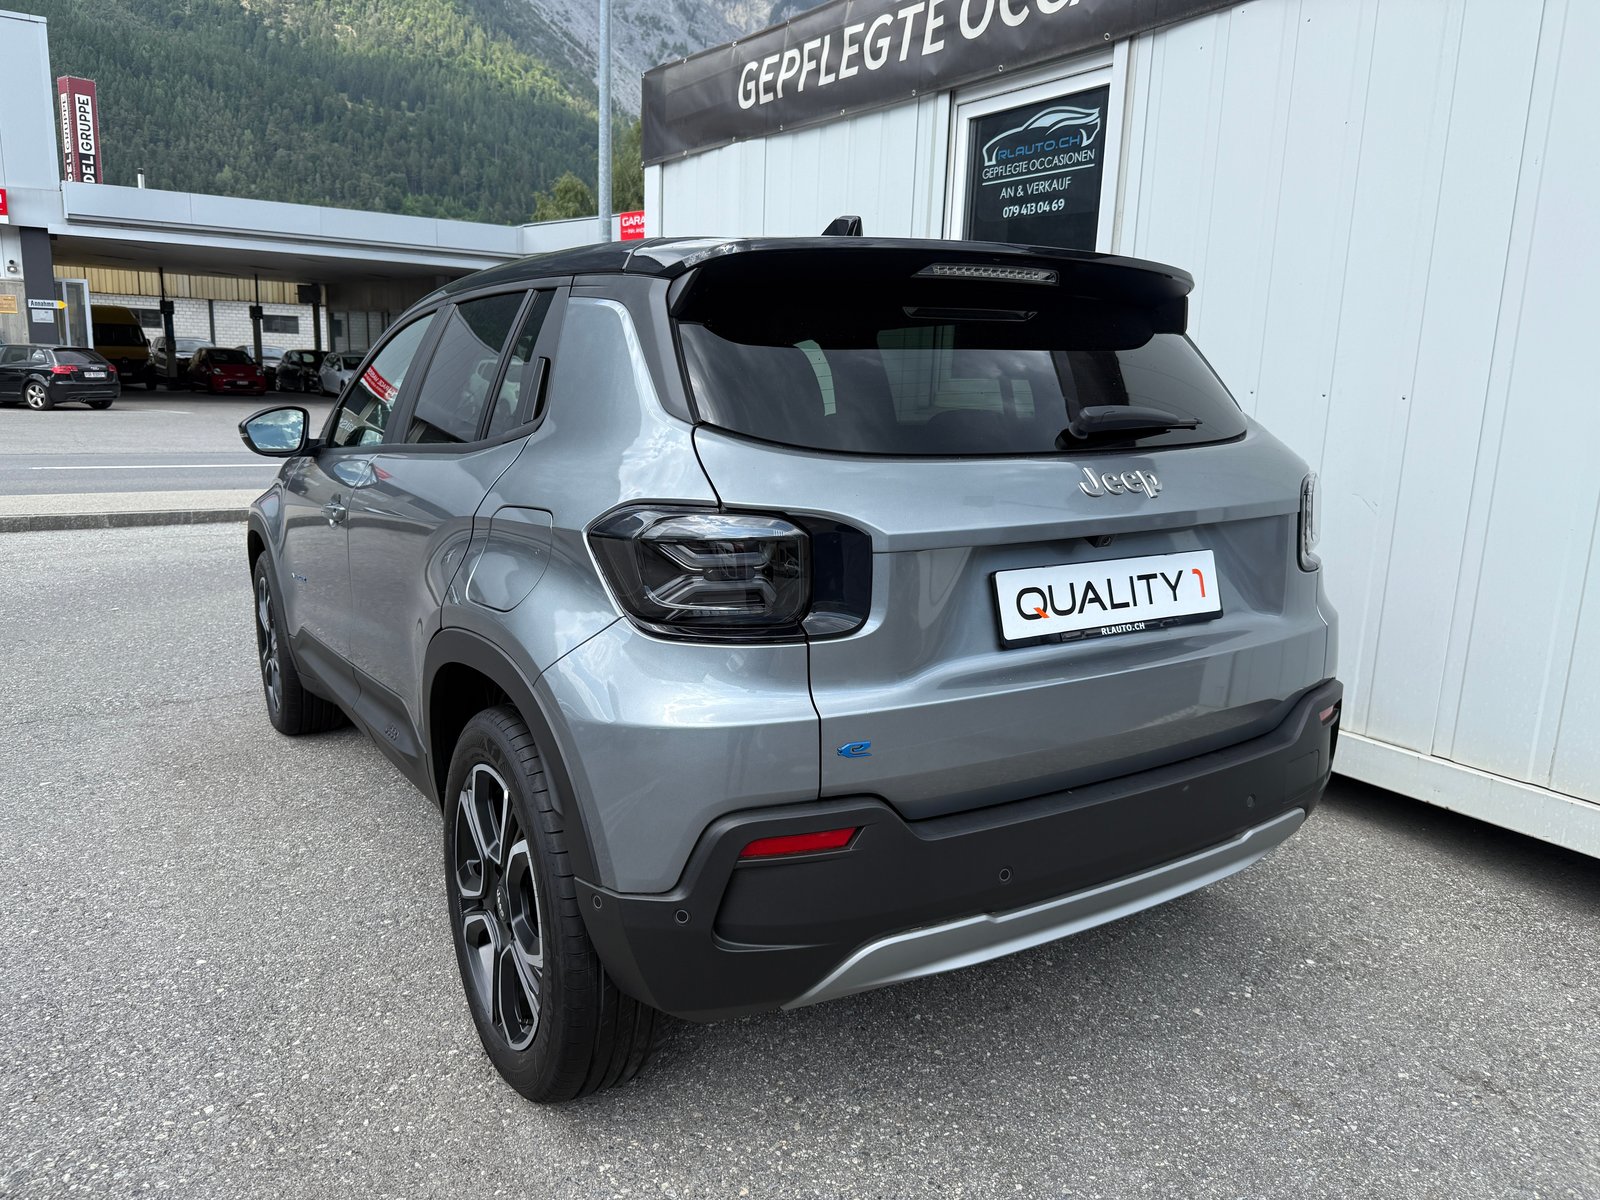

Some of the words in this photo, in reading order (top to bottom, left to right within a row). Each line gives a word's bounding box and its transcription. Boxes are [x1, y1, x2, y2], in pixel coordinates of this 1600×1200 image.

[738, 0, 945, 110] GEPFLEGTE
[77, 96, 93, 152] GRUPPE
[997, 135, 1081, 161] RLAUTO.CH
[982, 160, 1028, 180] GEPFLEGTE
[1029, 149, 1096, 172] OCCASIONEN
[1000, 186, 1015, 200] AN
[1016, 185, 1024, 198] &
[1026, 176, 1072, 195] VERKAUF
[1002, 205, 1020, 219] 079
[1020, 203, 1036, 216] 413
[1037, 201, 1050, 214] 04
[1051, 198, 1065, 212] 69
[30, 300, 55, 308] Annahme
[1078, 466, 1163, 499] Jeep
[1100, 621, 1146, 636] RLAUTO.CH
